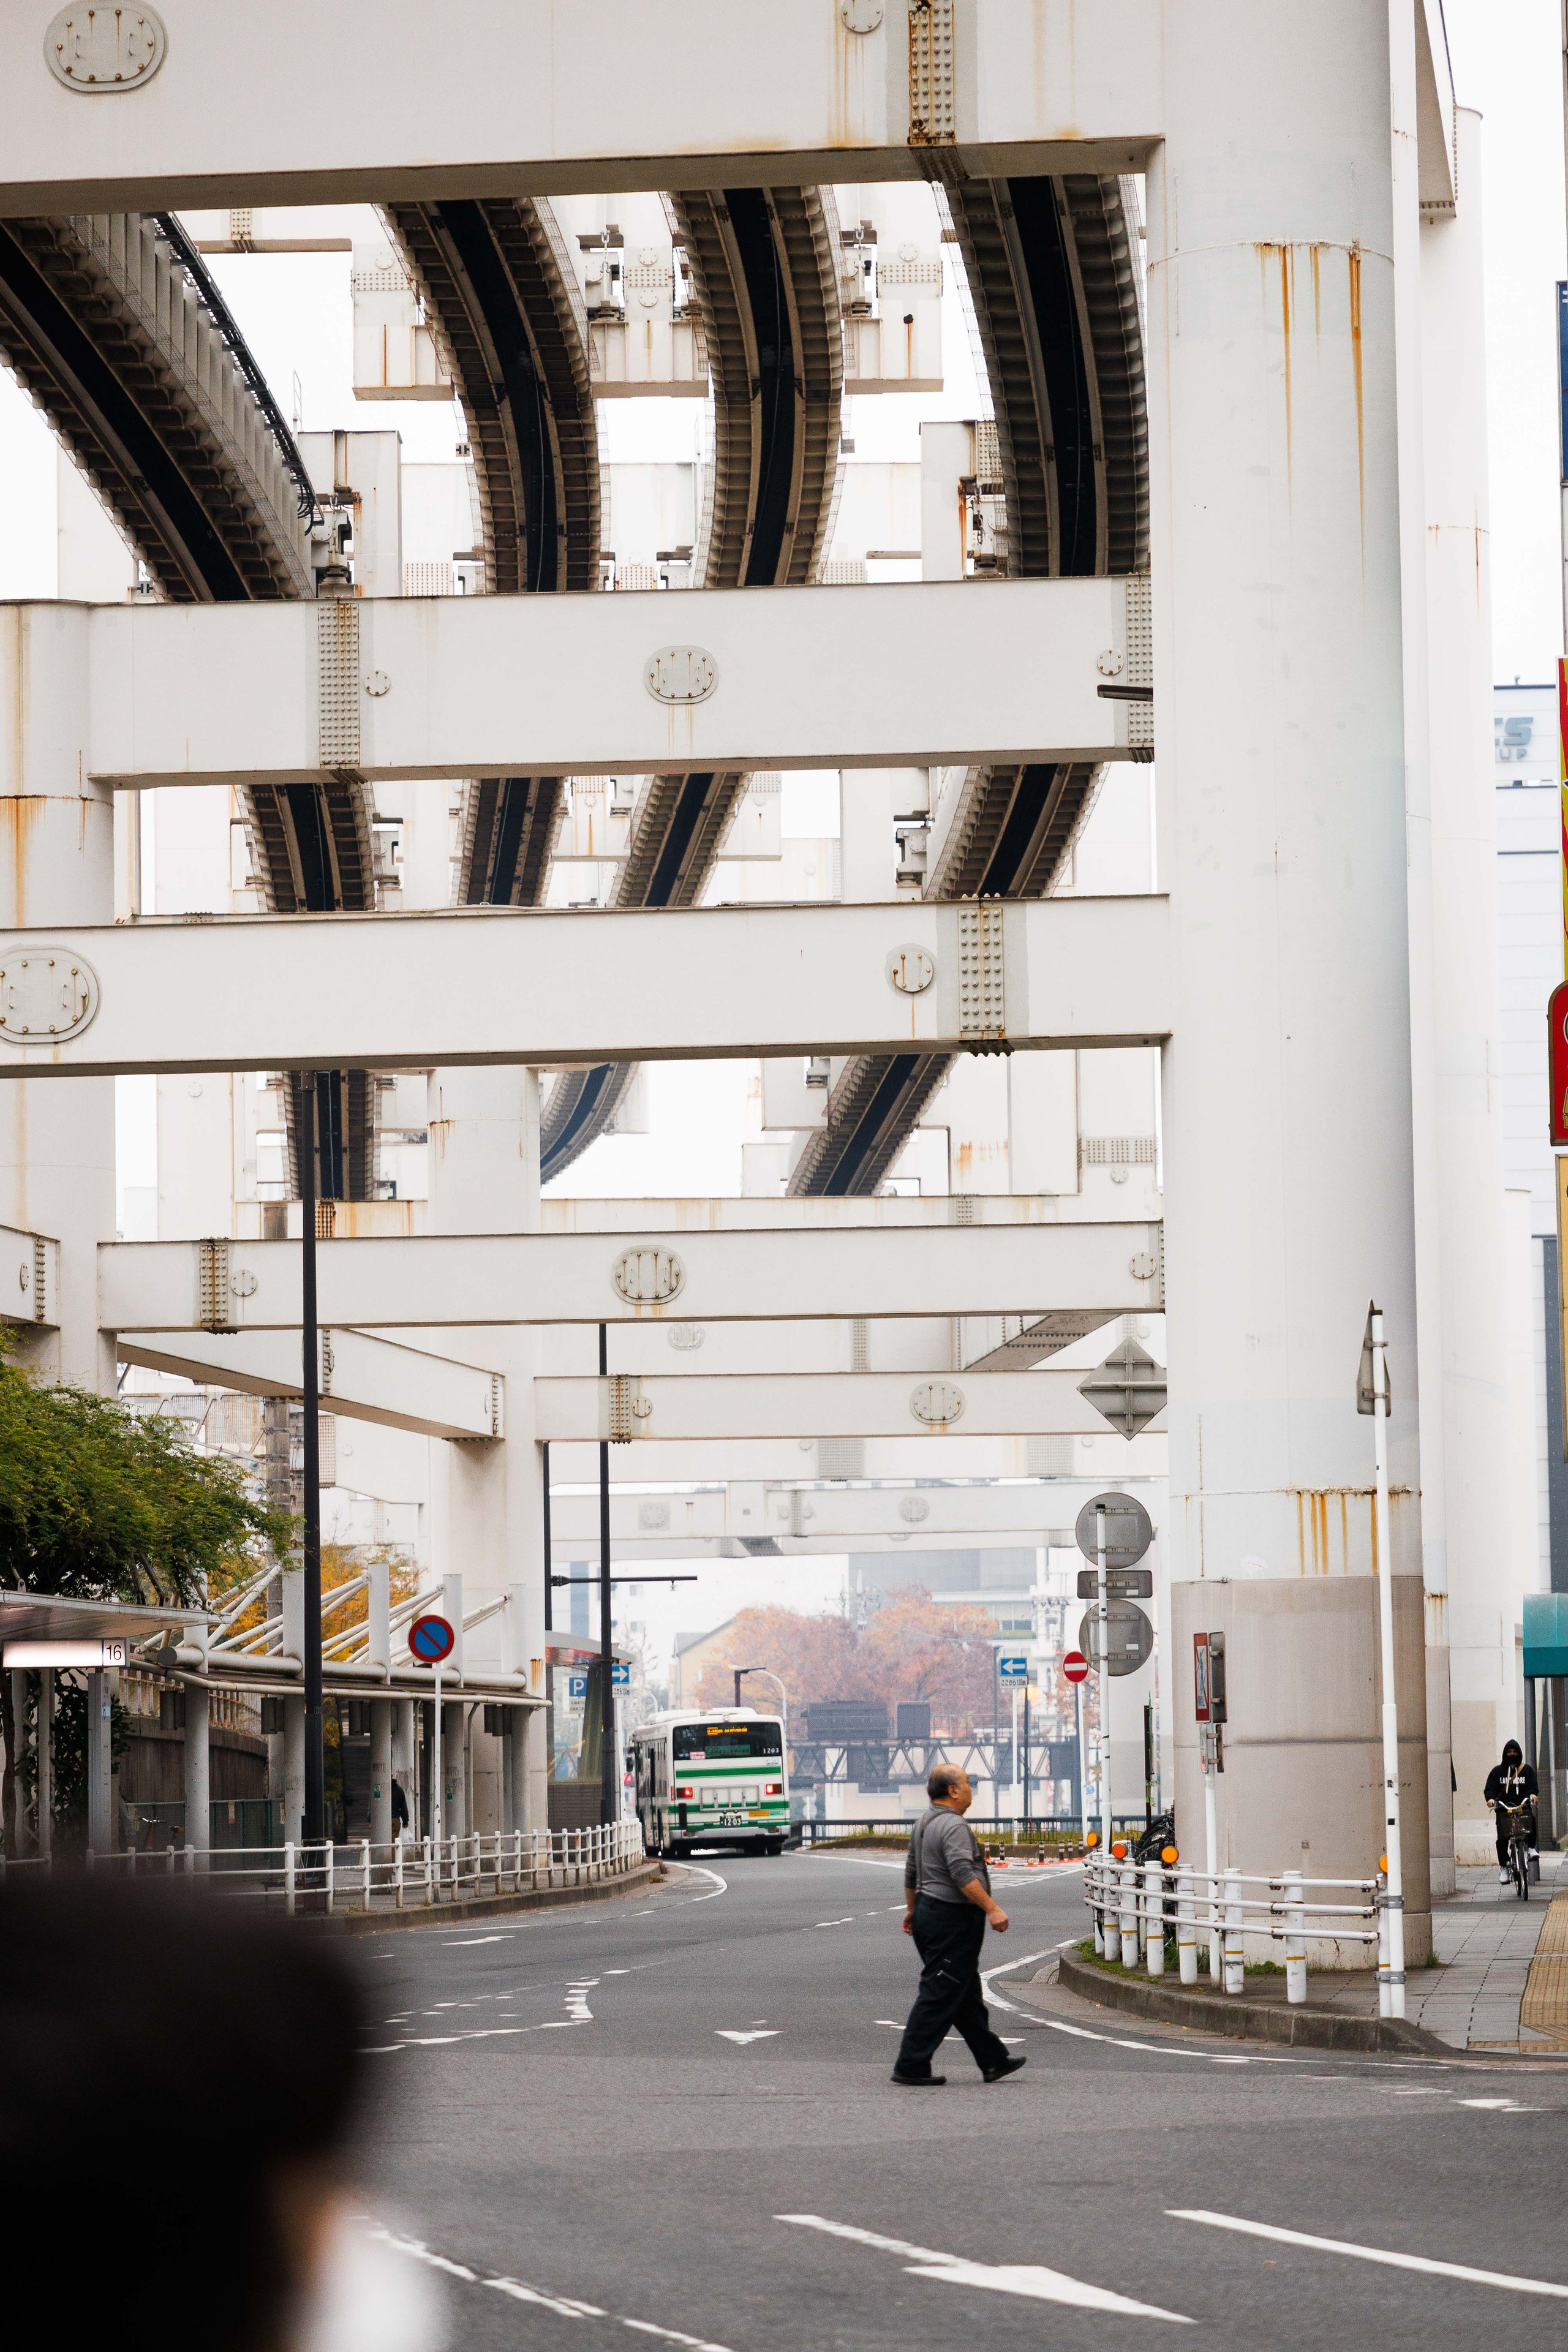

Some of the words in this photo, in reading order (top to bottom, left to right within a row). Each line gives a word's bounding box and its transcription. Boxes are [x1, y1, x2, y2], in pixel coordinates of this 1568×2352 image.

[1494, 717, 1534, 745] S
[106, 1645, 122, 1660] 16
[573, 1679, 584, 1695] P
